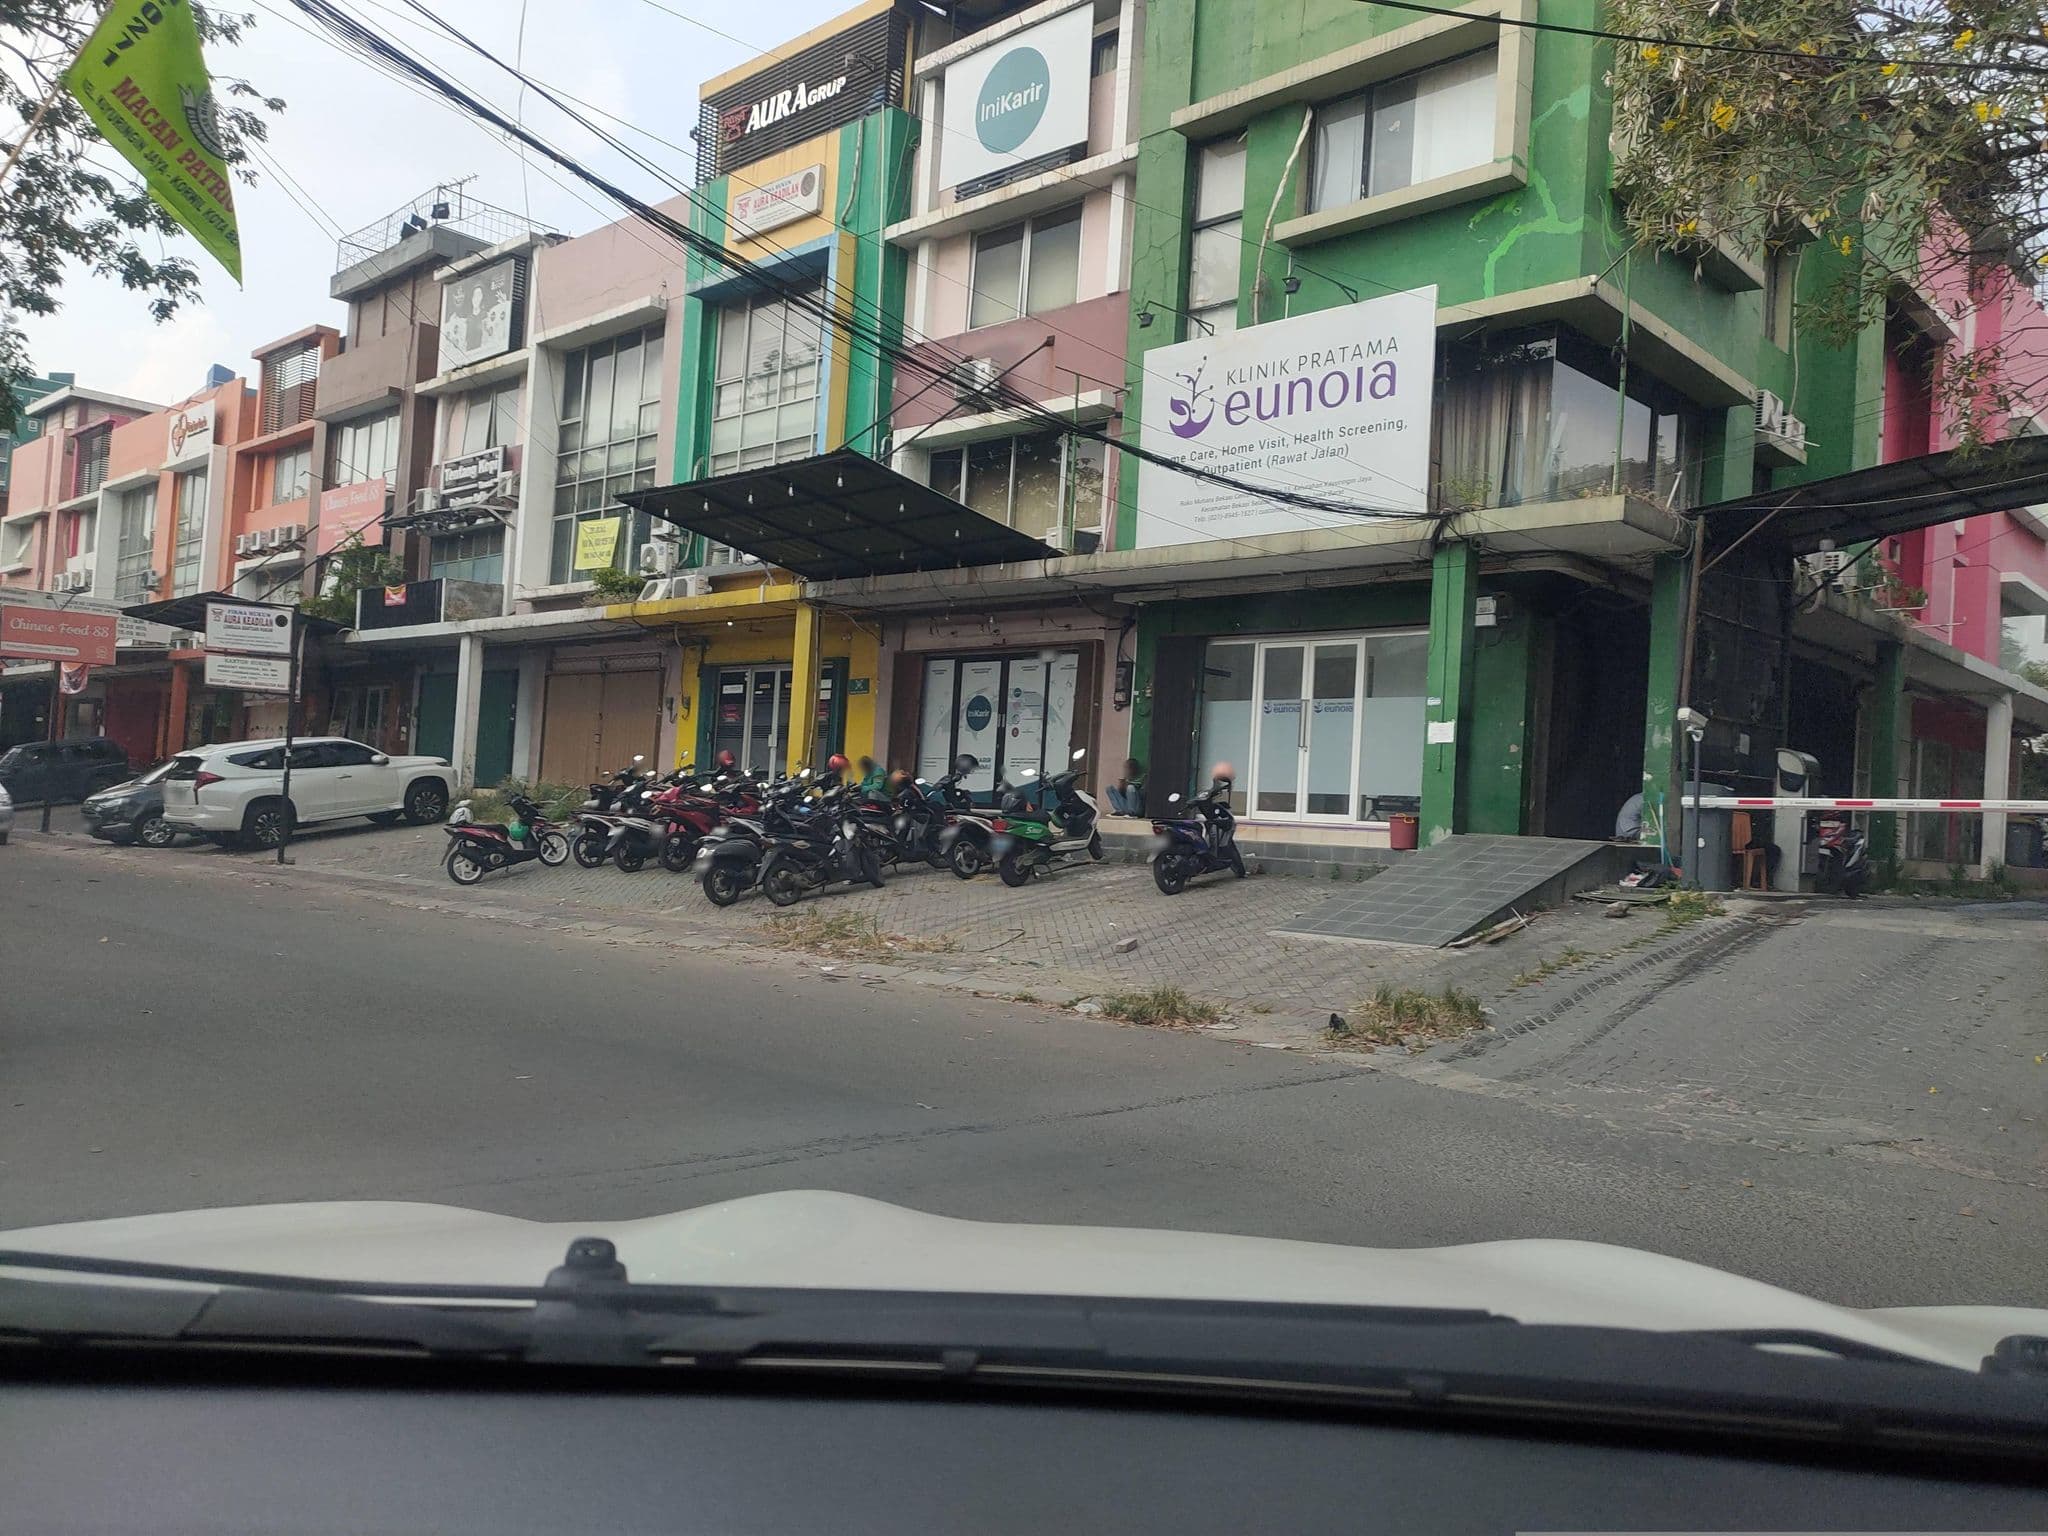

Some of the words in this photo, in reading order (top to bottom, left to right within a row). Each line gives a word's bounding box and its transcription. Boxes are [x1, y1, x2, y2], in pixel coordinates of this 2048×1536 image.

[111, 76, 184, 151] MACAN
[745, 82, 808, 133] AURA
[807, 76, 847, 106] GRUP
[981, 82, 1043, 122] IniKarir
[1226, 358, 1291, 386] KLINIK
[1297, 336, 1399, 372] PRATAMA
[1224, 360, 1397, 426] eunoia
[1189, 450, 1218, 462] Care,
[1221, 443, 1255, 456] Home
[1258, 436, 1289, 450] Visit,
[1294, 428, 1334, 445] Health
[1338, 419, 1408, 438] Screening,
[1266, 451, 1308, 469] (Rawat
[1311, 443, 1349, 460] Jalan)
[10, 617, 55, 633] Chinese
[59, 622, 90, 636] Food
[93, 626, 110, 637] 88
